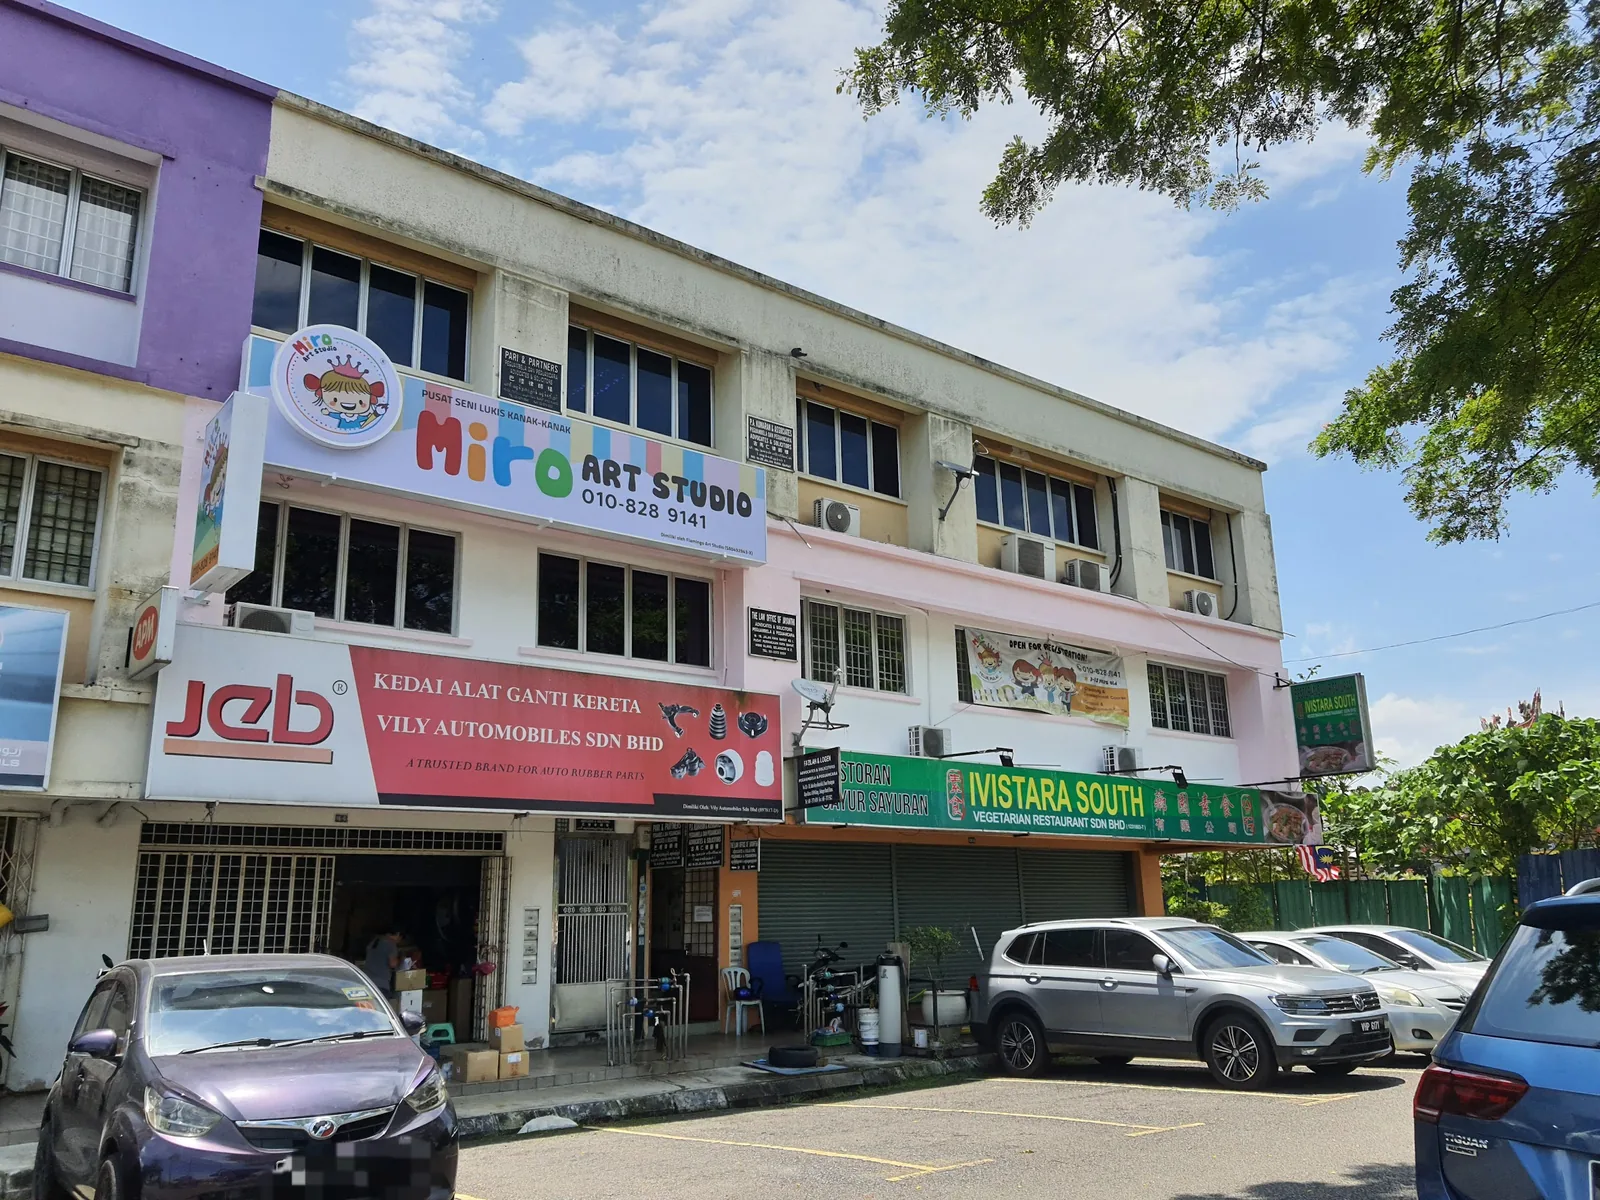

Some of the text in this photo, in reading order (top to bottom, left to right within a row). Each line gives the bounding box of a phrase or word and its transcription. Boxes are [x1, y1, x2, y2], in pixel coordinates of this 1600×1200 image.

[292, 334, 332, 356] Miro
[303, 346, 337, 362] Art Studio
[504, 350, 558, 373] PARI & PARTNERS
[421, 390, 571, 435] PUSAT SENI LUKIS KANAK-KANAK
[416, 410, 573, 498] Miro
[582, 454, 752, 518] ART STUDIO
[582, 488, 707, 529] 010-828 9141
[135, 613, 155, 651] APM
[1009, 640, 1026, 650] OPEN
[1028, 642, 1042, 651] FOR
[373, 672, 642, 714] KEDAI ALAT GANTI KERETA
[1334, 694, 1357, 710] SOUTH
[376, 714, 664, 752] VILY AUTOMOBILES SDN BHD
[406, 758, 645, 781] A TRUSTED BRAND FOR AUTO RUBBER PARTS
[840, 761, 891, 786] STORAN
[868, 791, 929, 816] SAYURAN
[969, 772, 1145, 817] IVISTARA SOUTH
[973, 811, 1032, 825] VEGETARIAN
[1033, 814, 1089, 828] RESTAURANT
[1090, 817, 1107, 829] SDN
[1109, 819, 1125, 830] BHD
[1444, 1132, 1488, 1149] TIGUAN
